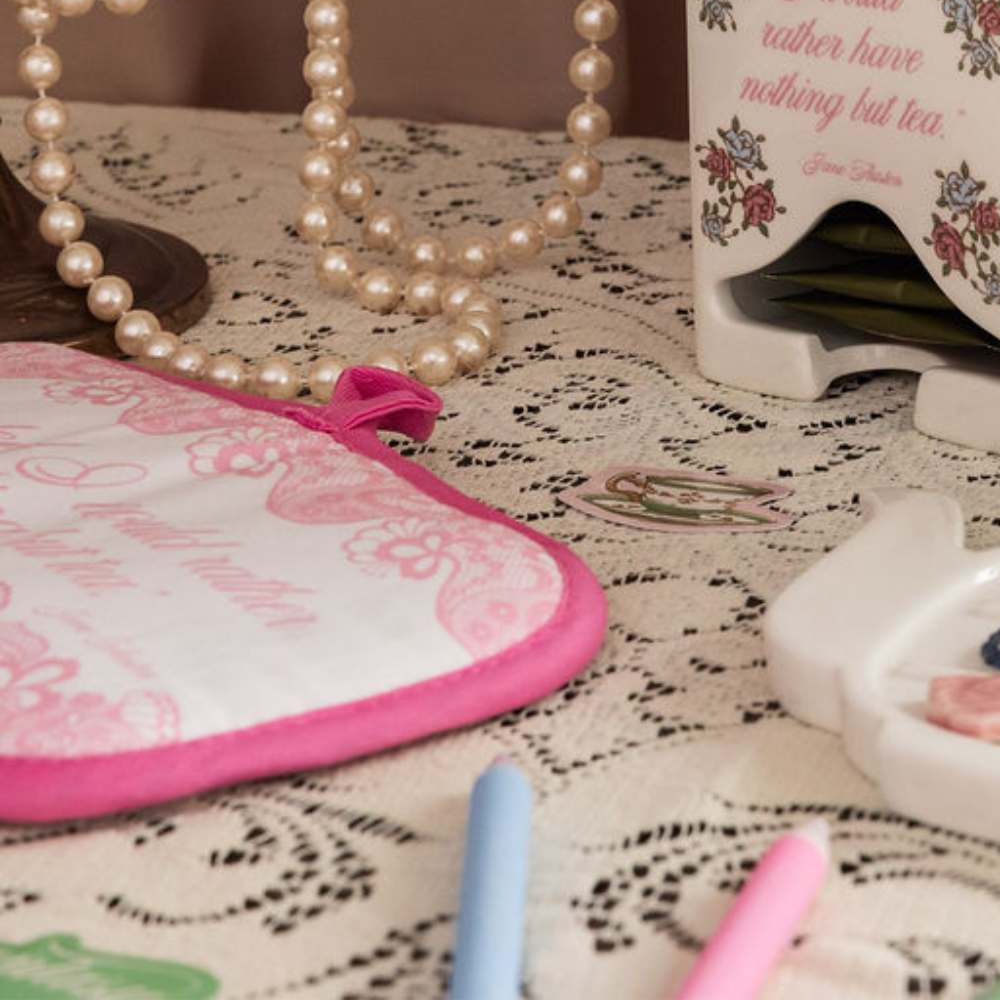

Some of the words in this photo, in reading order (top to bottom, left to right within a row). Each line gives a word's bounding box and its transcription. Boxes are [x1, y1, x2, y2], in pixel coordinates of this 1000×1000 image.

[762, 17, 845, 58] rather
[849, 27, 924, 73] have
[739, 71, 844, 133] nothing
[850, 86, 896, 128] but
